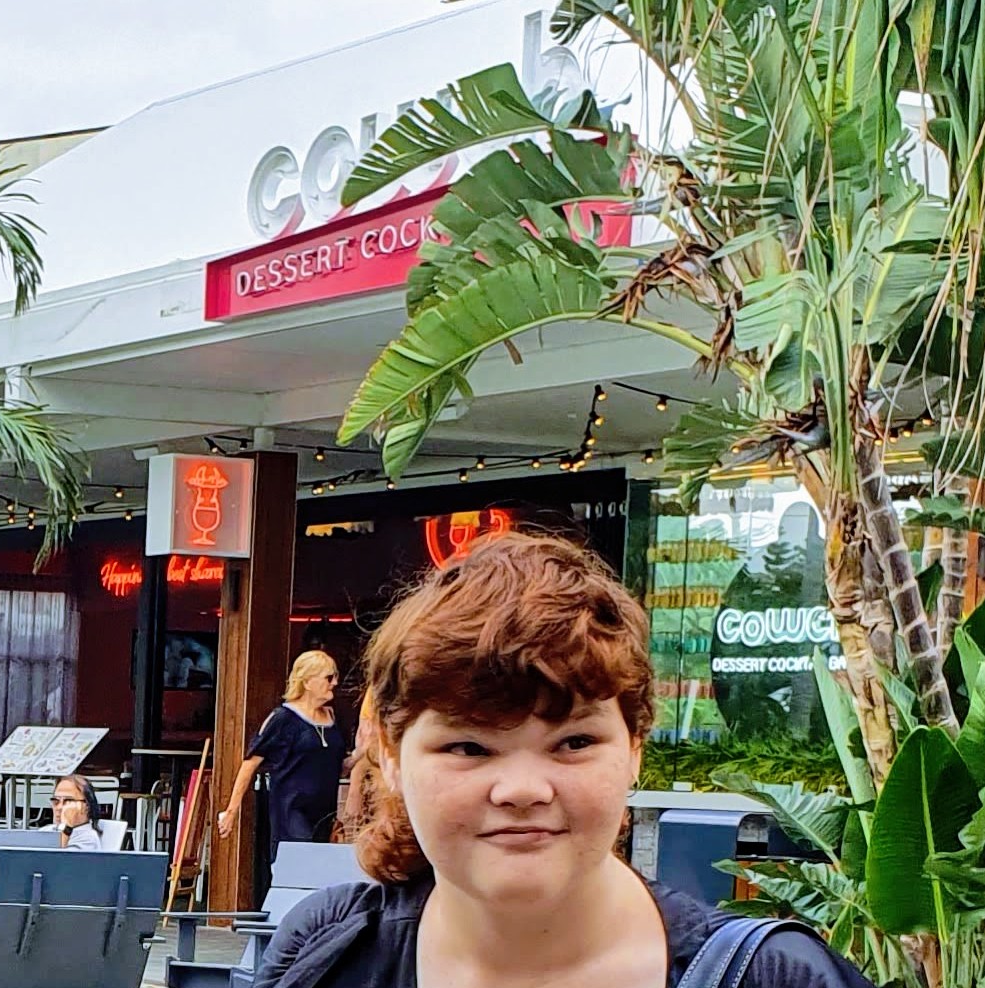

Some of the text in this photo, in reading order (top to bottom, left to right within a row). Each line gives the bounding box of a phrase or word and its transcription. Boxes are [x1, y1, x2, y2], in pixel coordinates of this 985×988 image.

[236, 213, 438, 298] DESSERT COCK
[100, 561, 142, 597] Happin
[712, 655, 848, 673] DESSERT COCKT BA
